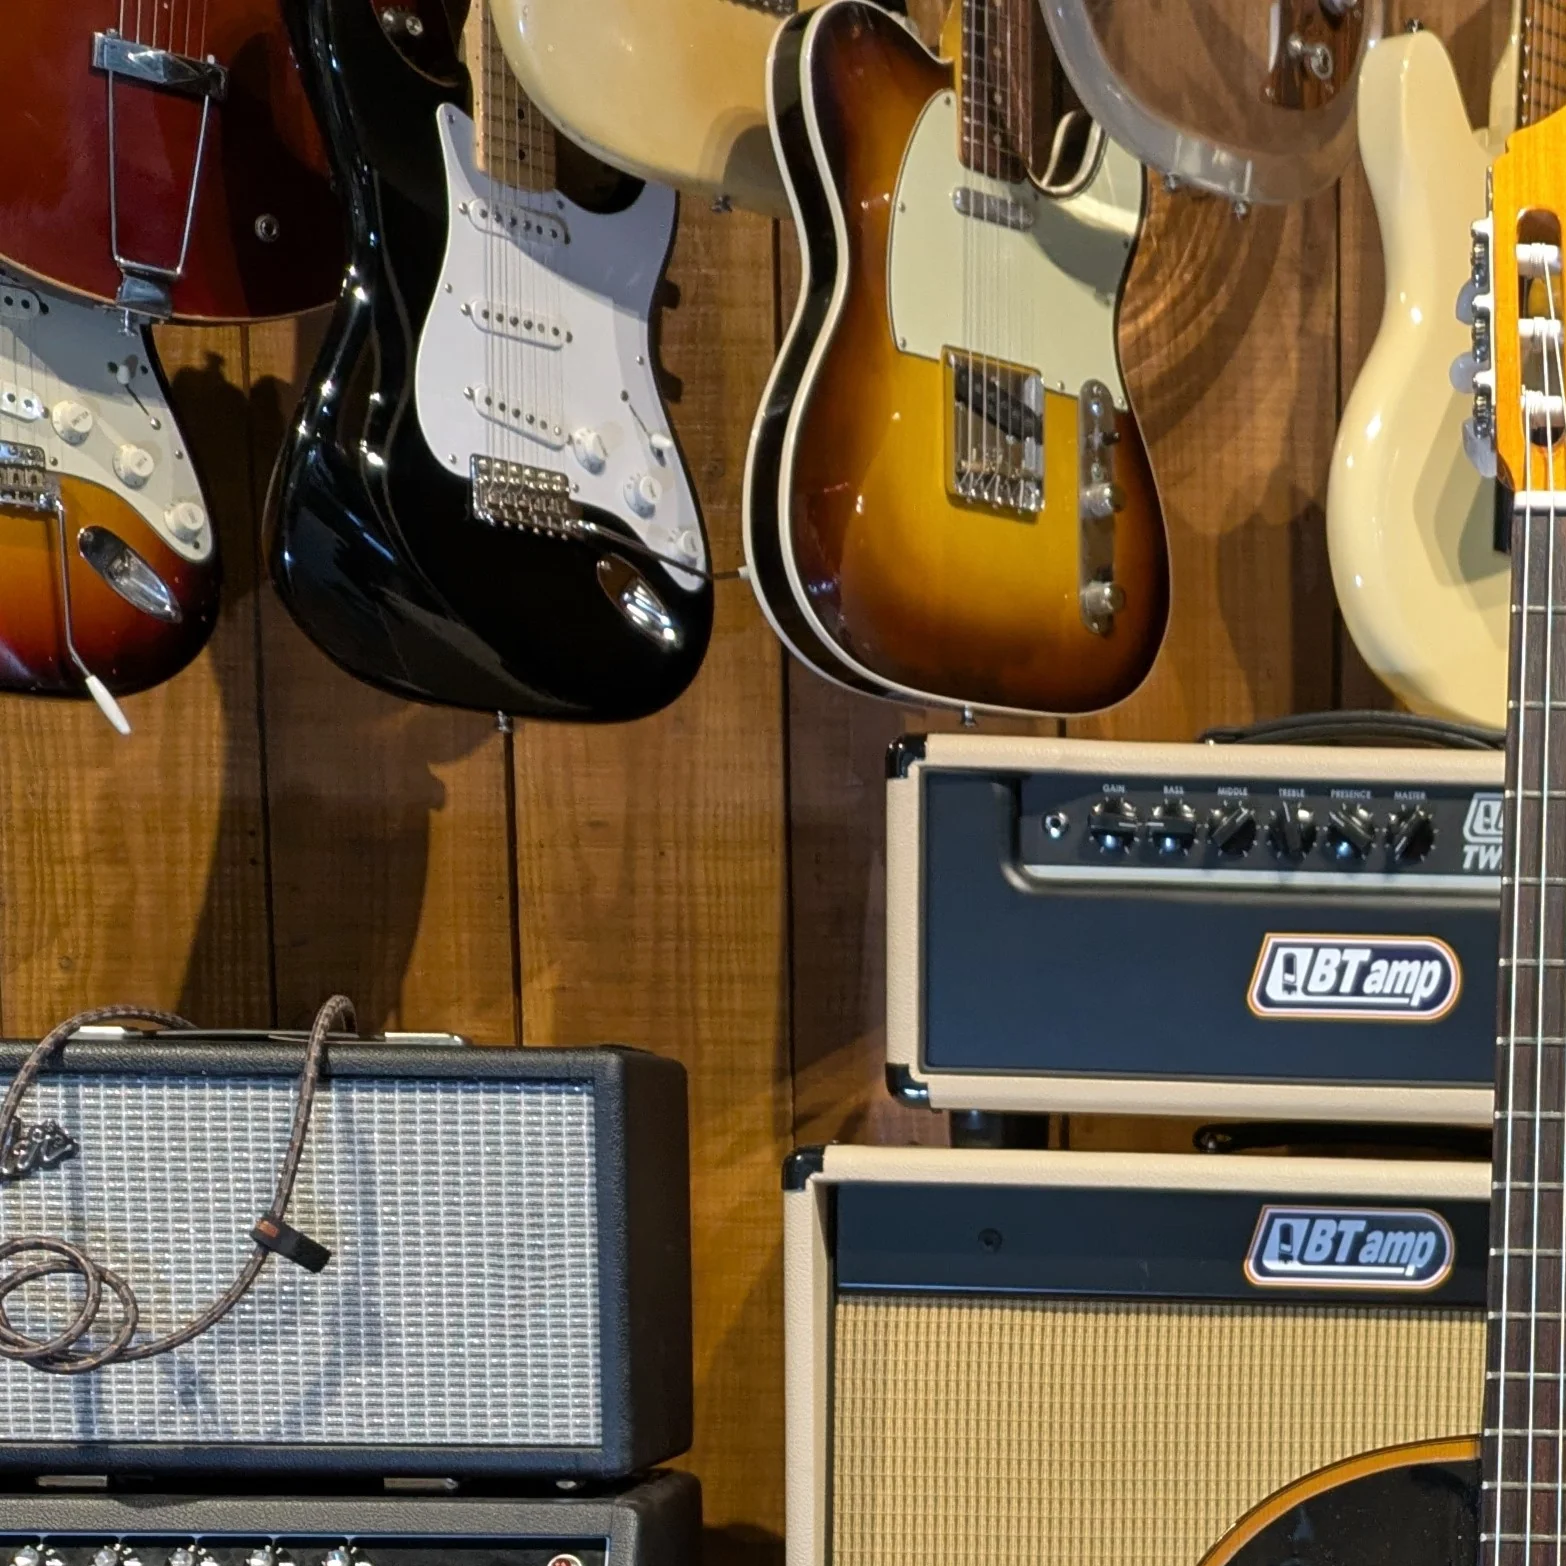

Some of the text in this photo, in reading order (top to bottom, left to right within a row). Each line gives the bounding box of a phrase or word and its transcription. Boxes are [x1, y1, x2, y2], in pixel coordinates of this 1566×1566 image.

[1102, 783, 1126, 794] GAIN
[1163, 785, 1185, 796] BASS
[1217, 786, 1249, 797] MIDDLE
[1278, 788, 1305, 798] TREBLE
[1330, 788, 1372, 799] PRESENCE
[1393, 790, 1427, 801] MASTER
[1463, 845, 1503, 870] TW
